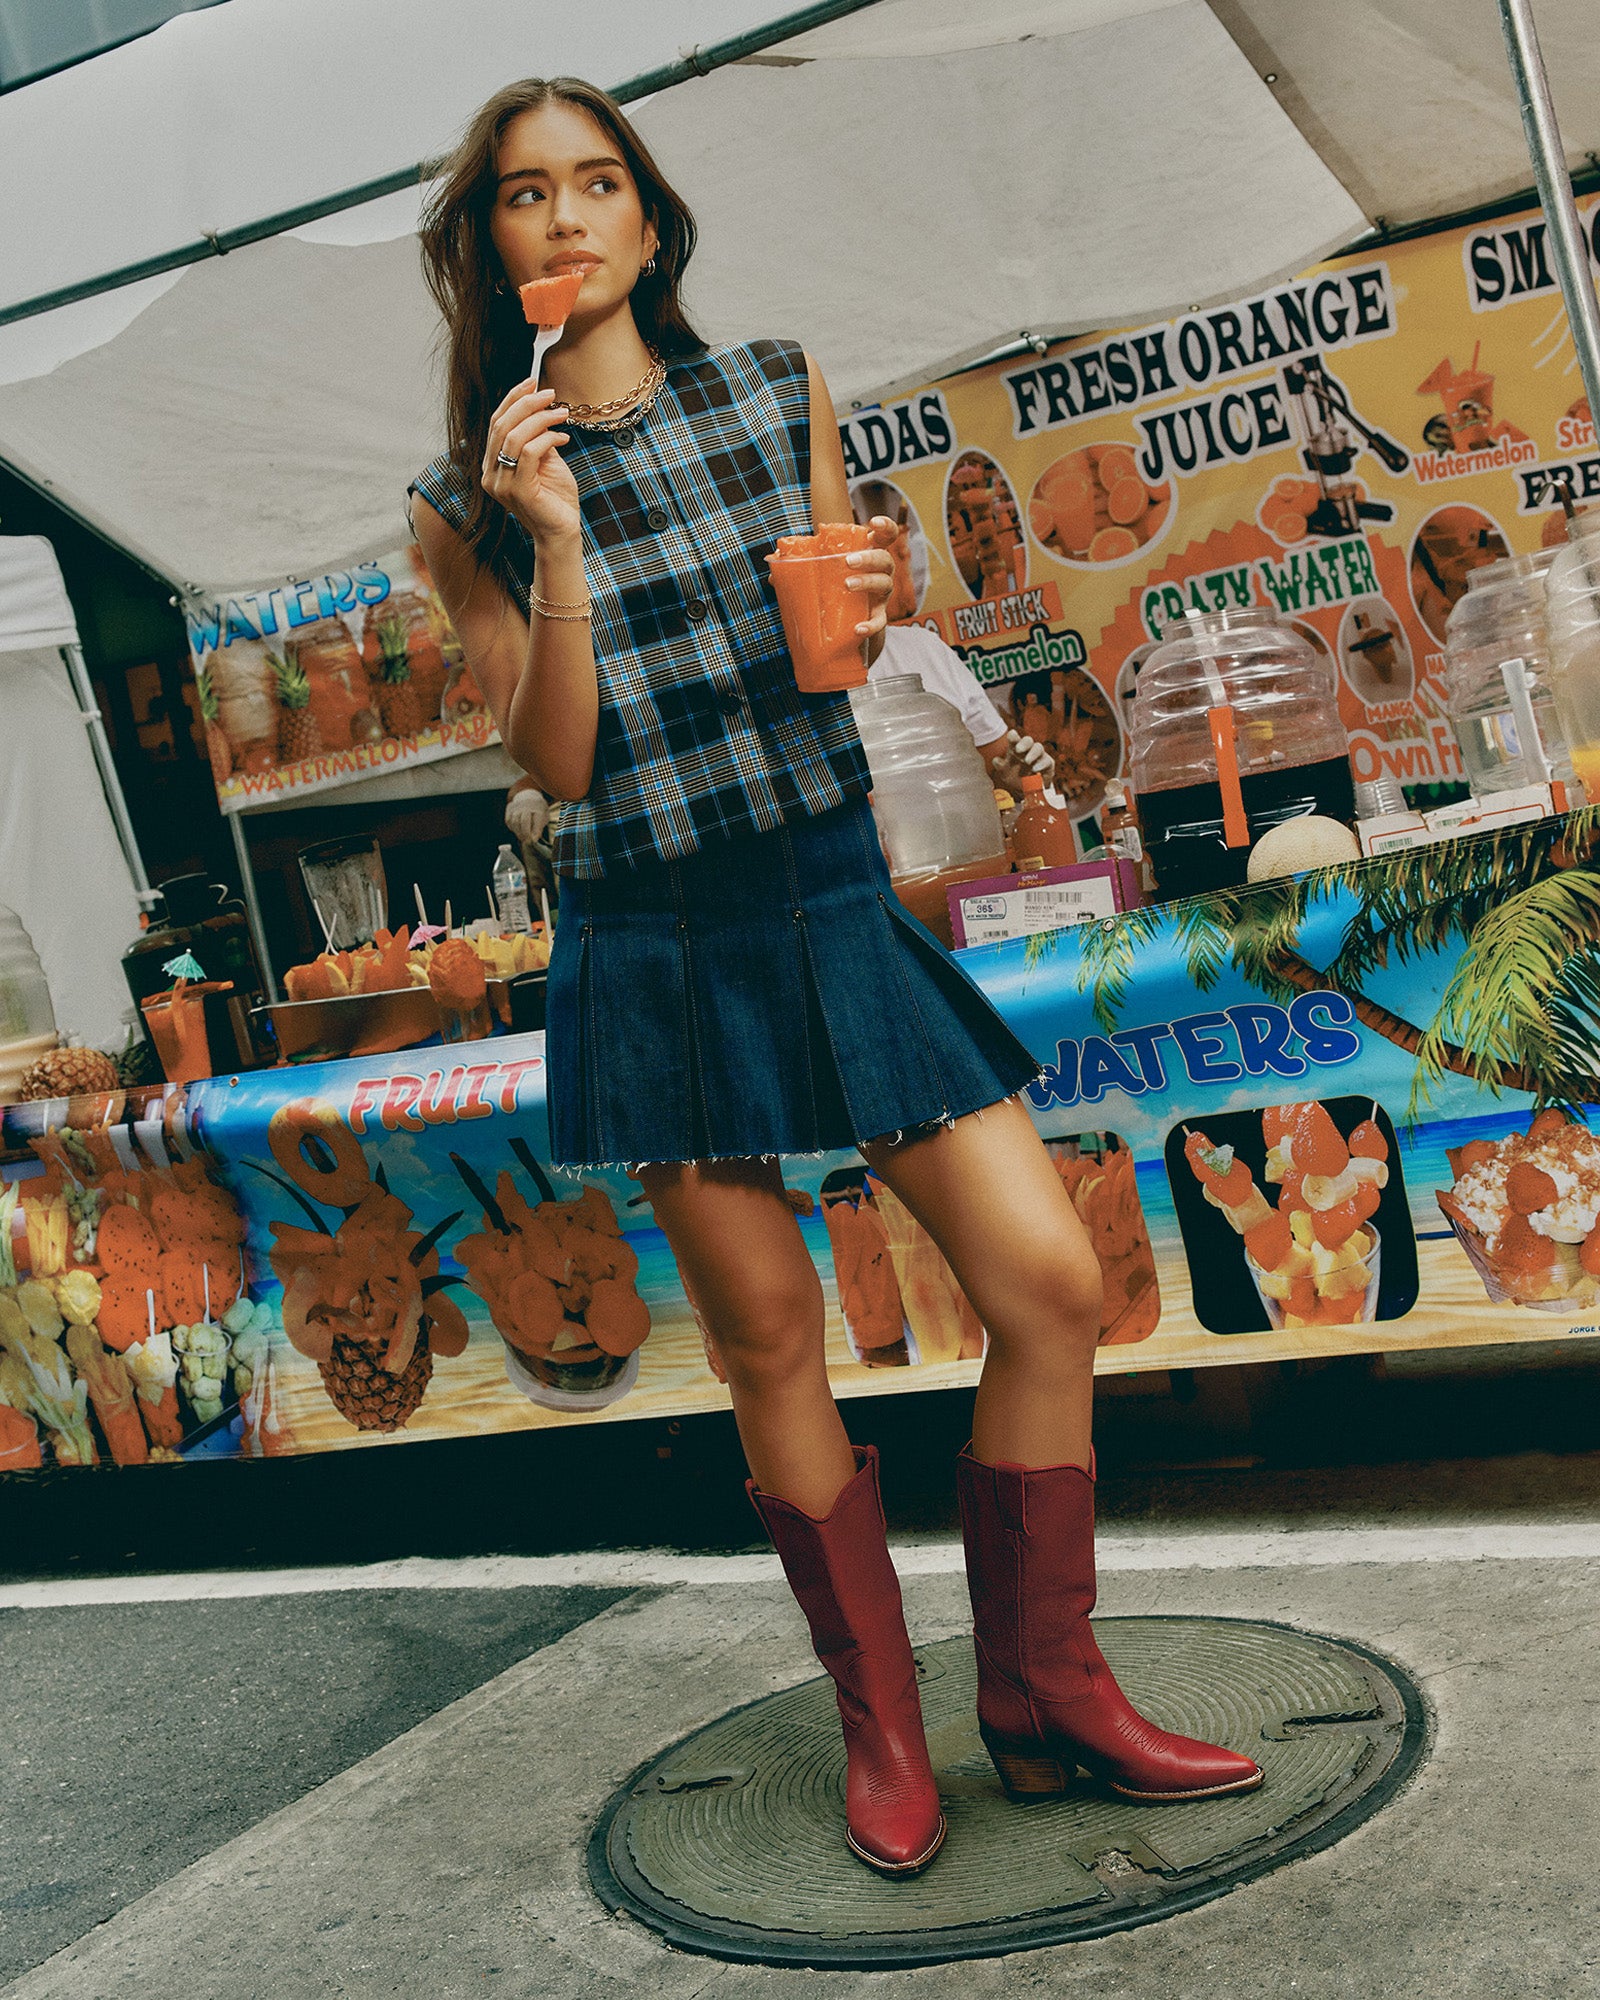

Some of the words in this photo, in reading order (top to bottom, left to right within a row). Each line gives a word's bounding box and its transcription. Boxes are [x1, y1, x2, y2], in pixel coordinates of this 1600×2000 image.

[1006, 331, 1177, 433] FRESH
[1178, 269, 1391, 383] ORANGE
[1140, 383, 1291, 480] JUICE
[1413, 437, 1536, 483] Watermelon
[186, 560, 391, 655] WATERS
[953, 600, 1000, 642] FRUIT
[1000, 587, 1051, 630] STICK
[1145, 567, 1253, 642] CRAZY
[1258, 539, 1379, 614] WATER
[967, 630, 1071, 683] termelon
[239, 734, 420, 797] WATERMELON
[1348, 735, 1435, 784] Own
[1026, 988, 1361, 1111] WATERS
[348, 1056, 545, 1135] FRUIT
[1568, 1326, 1596, 1334] JORGE
